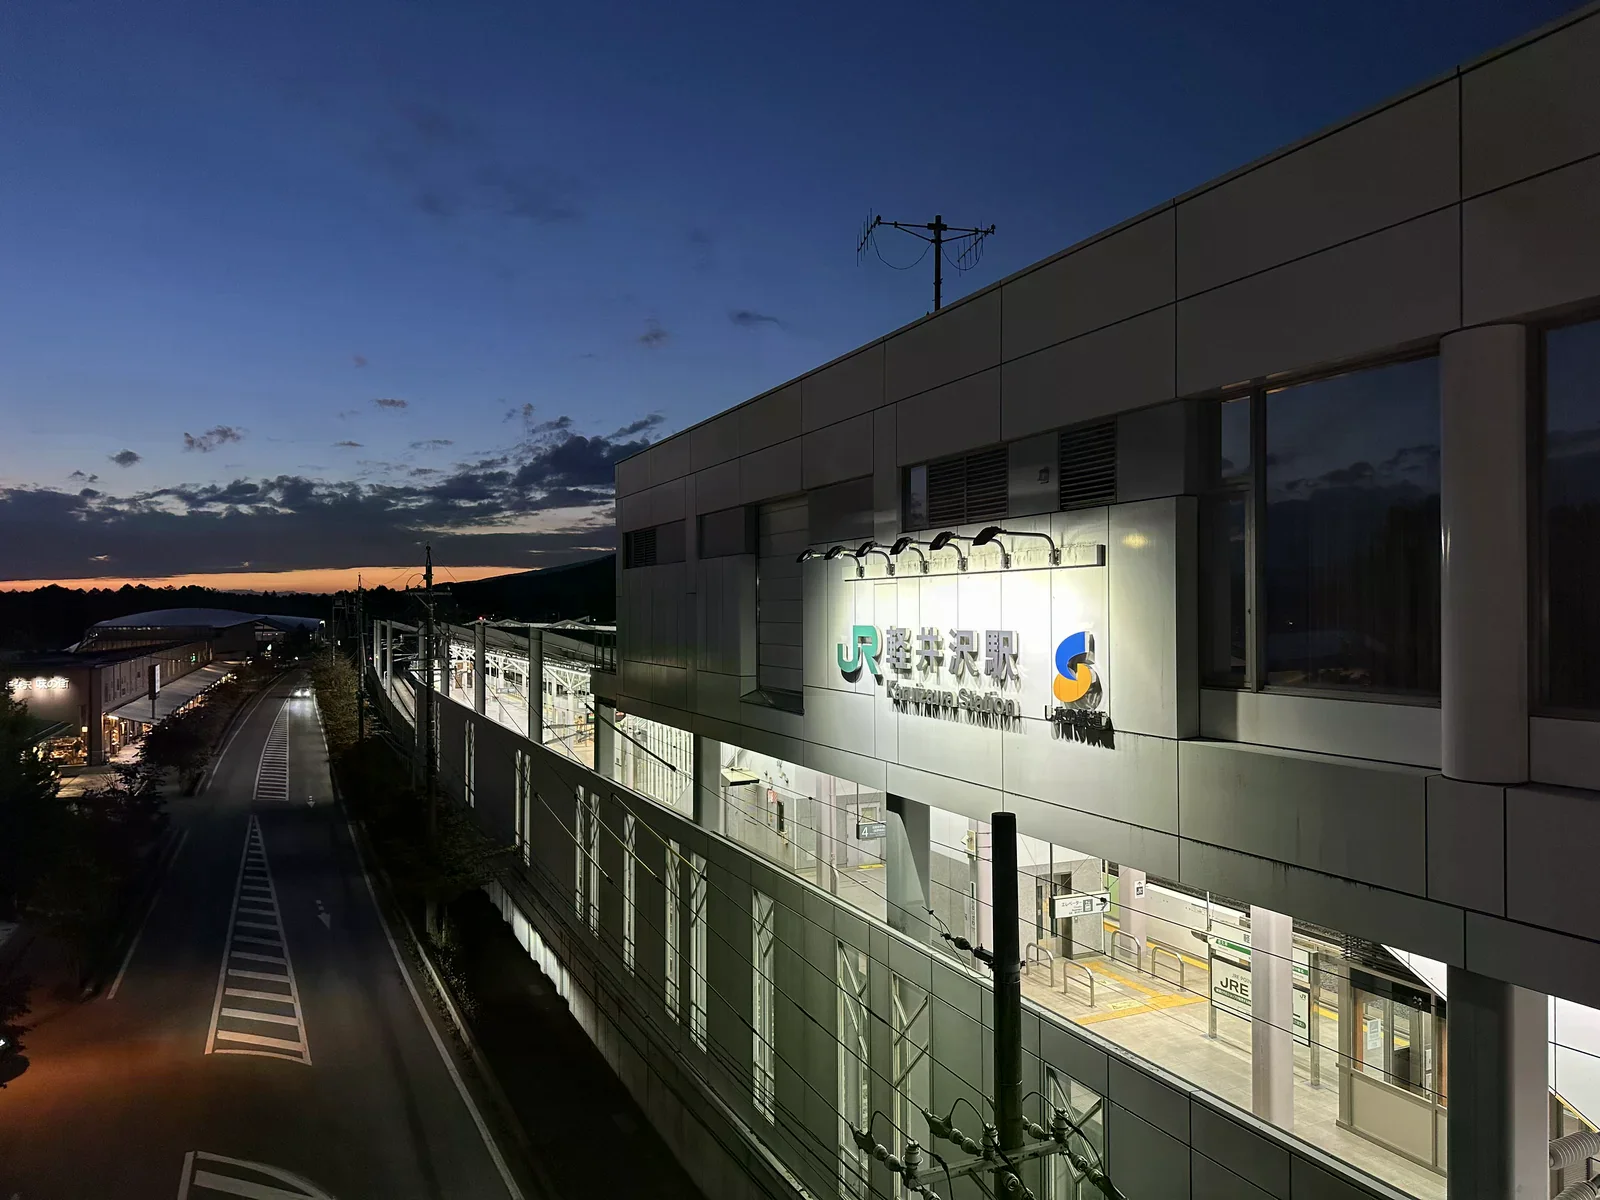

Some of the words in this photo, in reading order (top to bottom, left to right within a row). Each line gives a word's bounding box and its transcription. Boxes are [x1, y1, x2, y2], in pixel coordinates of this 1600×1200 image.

[837, 625, 880, 675] JR
[886, 626, 1019, 677] 軽井沢駅
[887, 680, 957, 708] Karuizawa
[958, 688, 1016, 717] Station
[861, 826, 869, 838] 4
[1220, 977, 1249, 997] JRE
